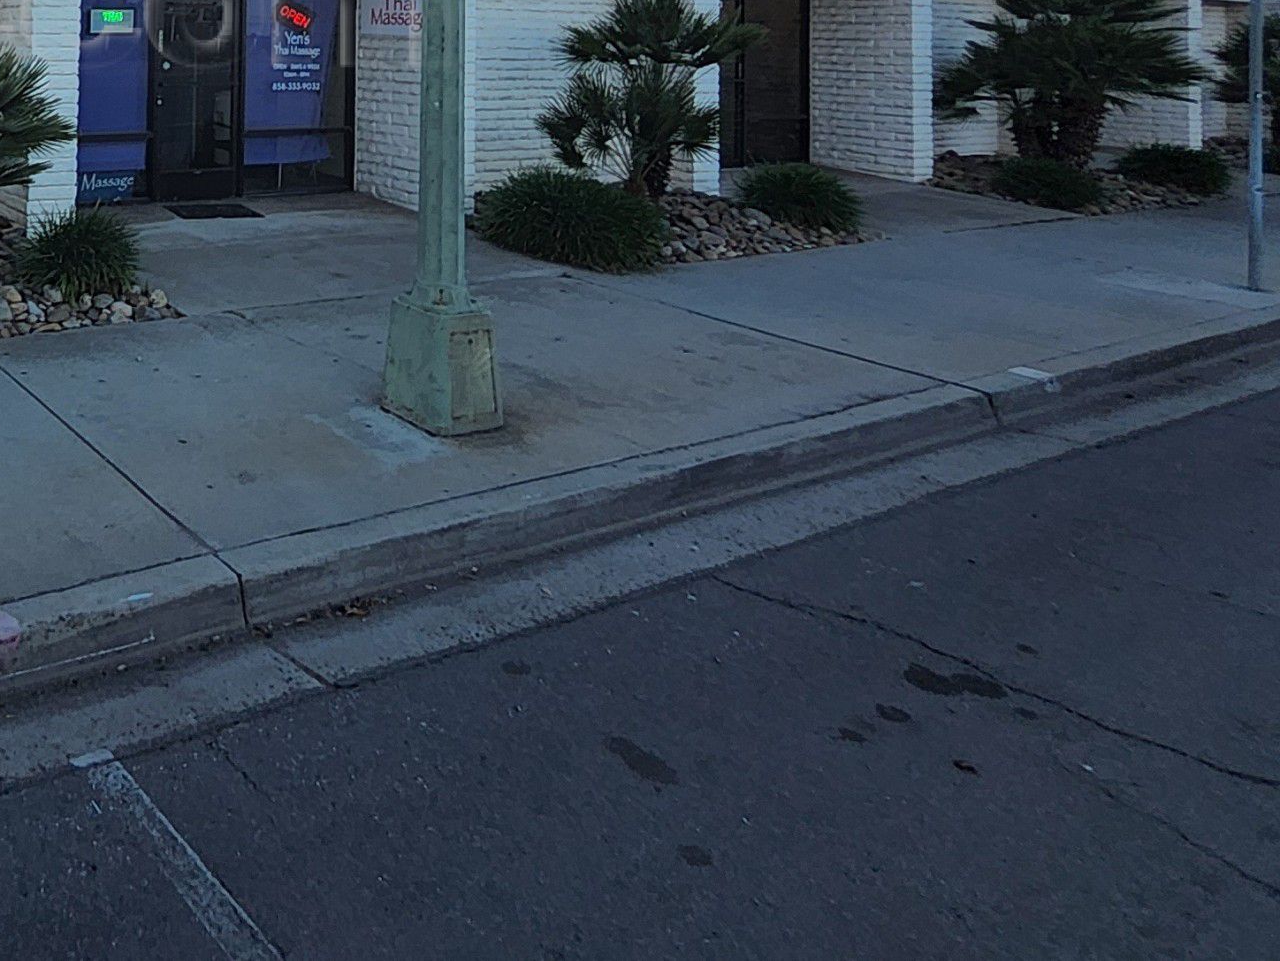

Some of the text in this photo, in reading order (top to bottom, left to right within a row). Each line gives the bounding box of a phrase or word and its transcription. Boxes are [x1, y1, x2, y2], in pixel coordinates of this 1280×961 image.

[280, 5, 310, 28] OPEN
[369, 8, 423, 32] Massag
[284, 31, 310, 45] Yen's
[273, 42, 320, 58] Thai Massage
[81, 172, 135, 192] Massage
